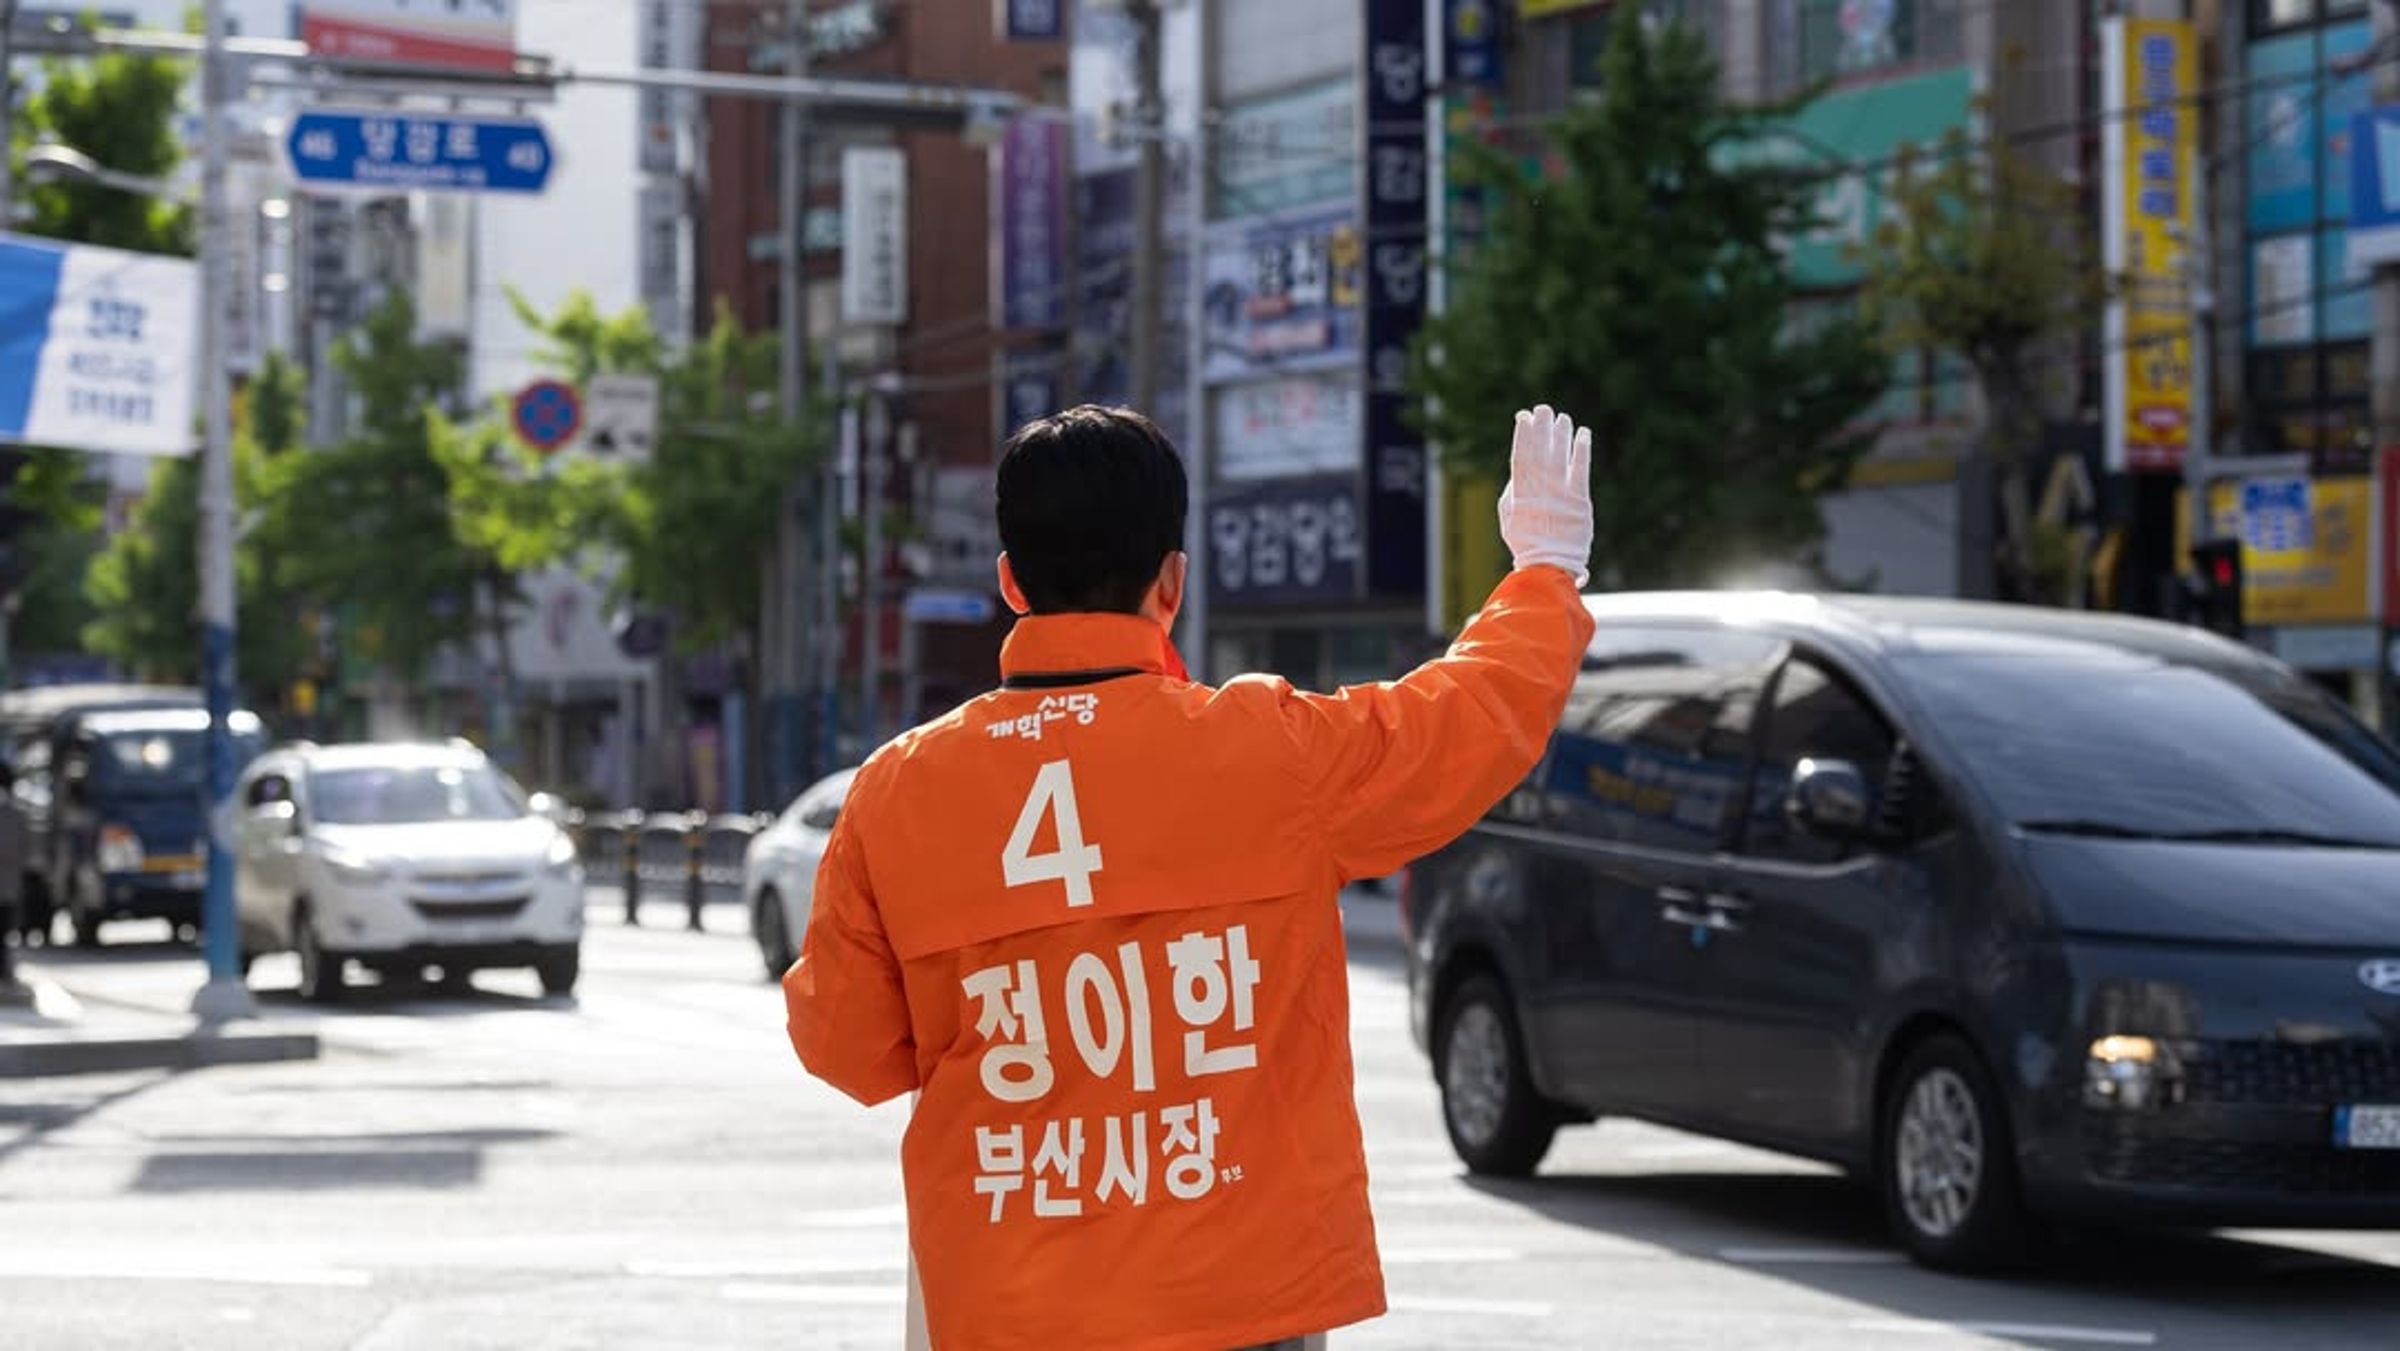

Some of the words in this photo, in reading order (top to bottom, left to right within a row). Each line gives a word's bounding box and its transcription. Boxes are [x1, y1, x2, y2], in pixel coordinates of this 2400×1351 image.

[361, 119, 481, 166] 당감로
[986, 693, 1099, 741] 개혁신당
[1001, 758, 1103, 908] 4
[961, 924, 1260, 1102] 정이한
[973, 1098, 1221, 1223] 부산시장
[1220, 1164, 1245, 1184] 후보
